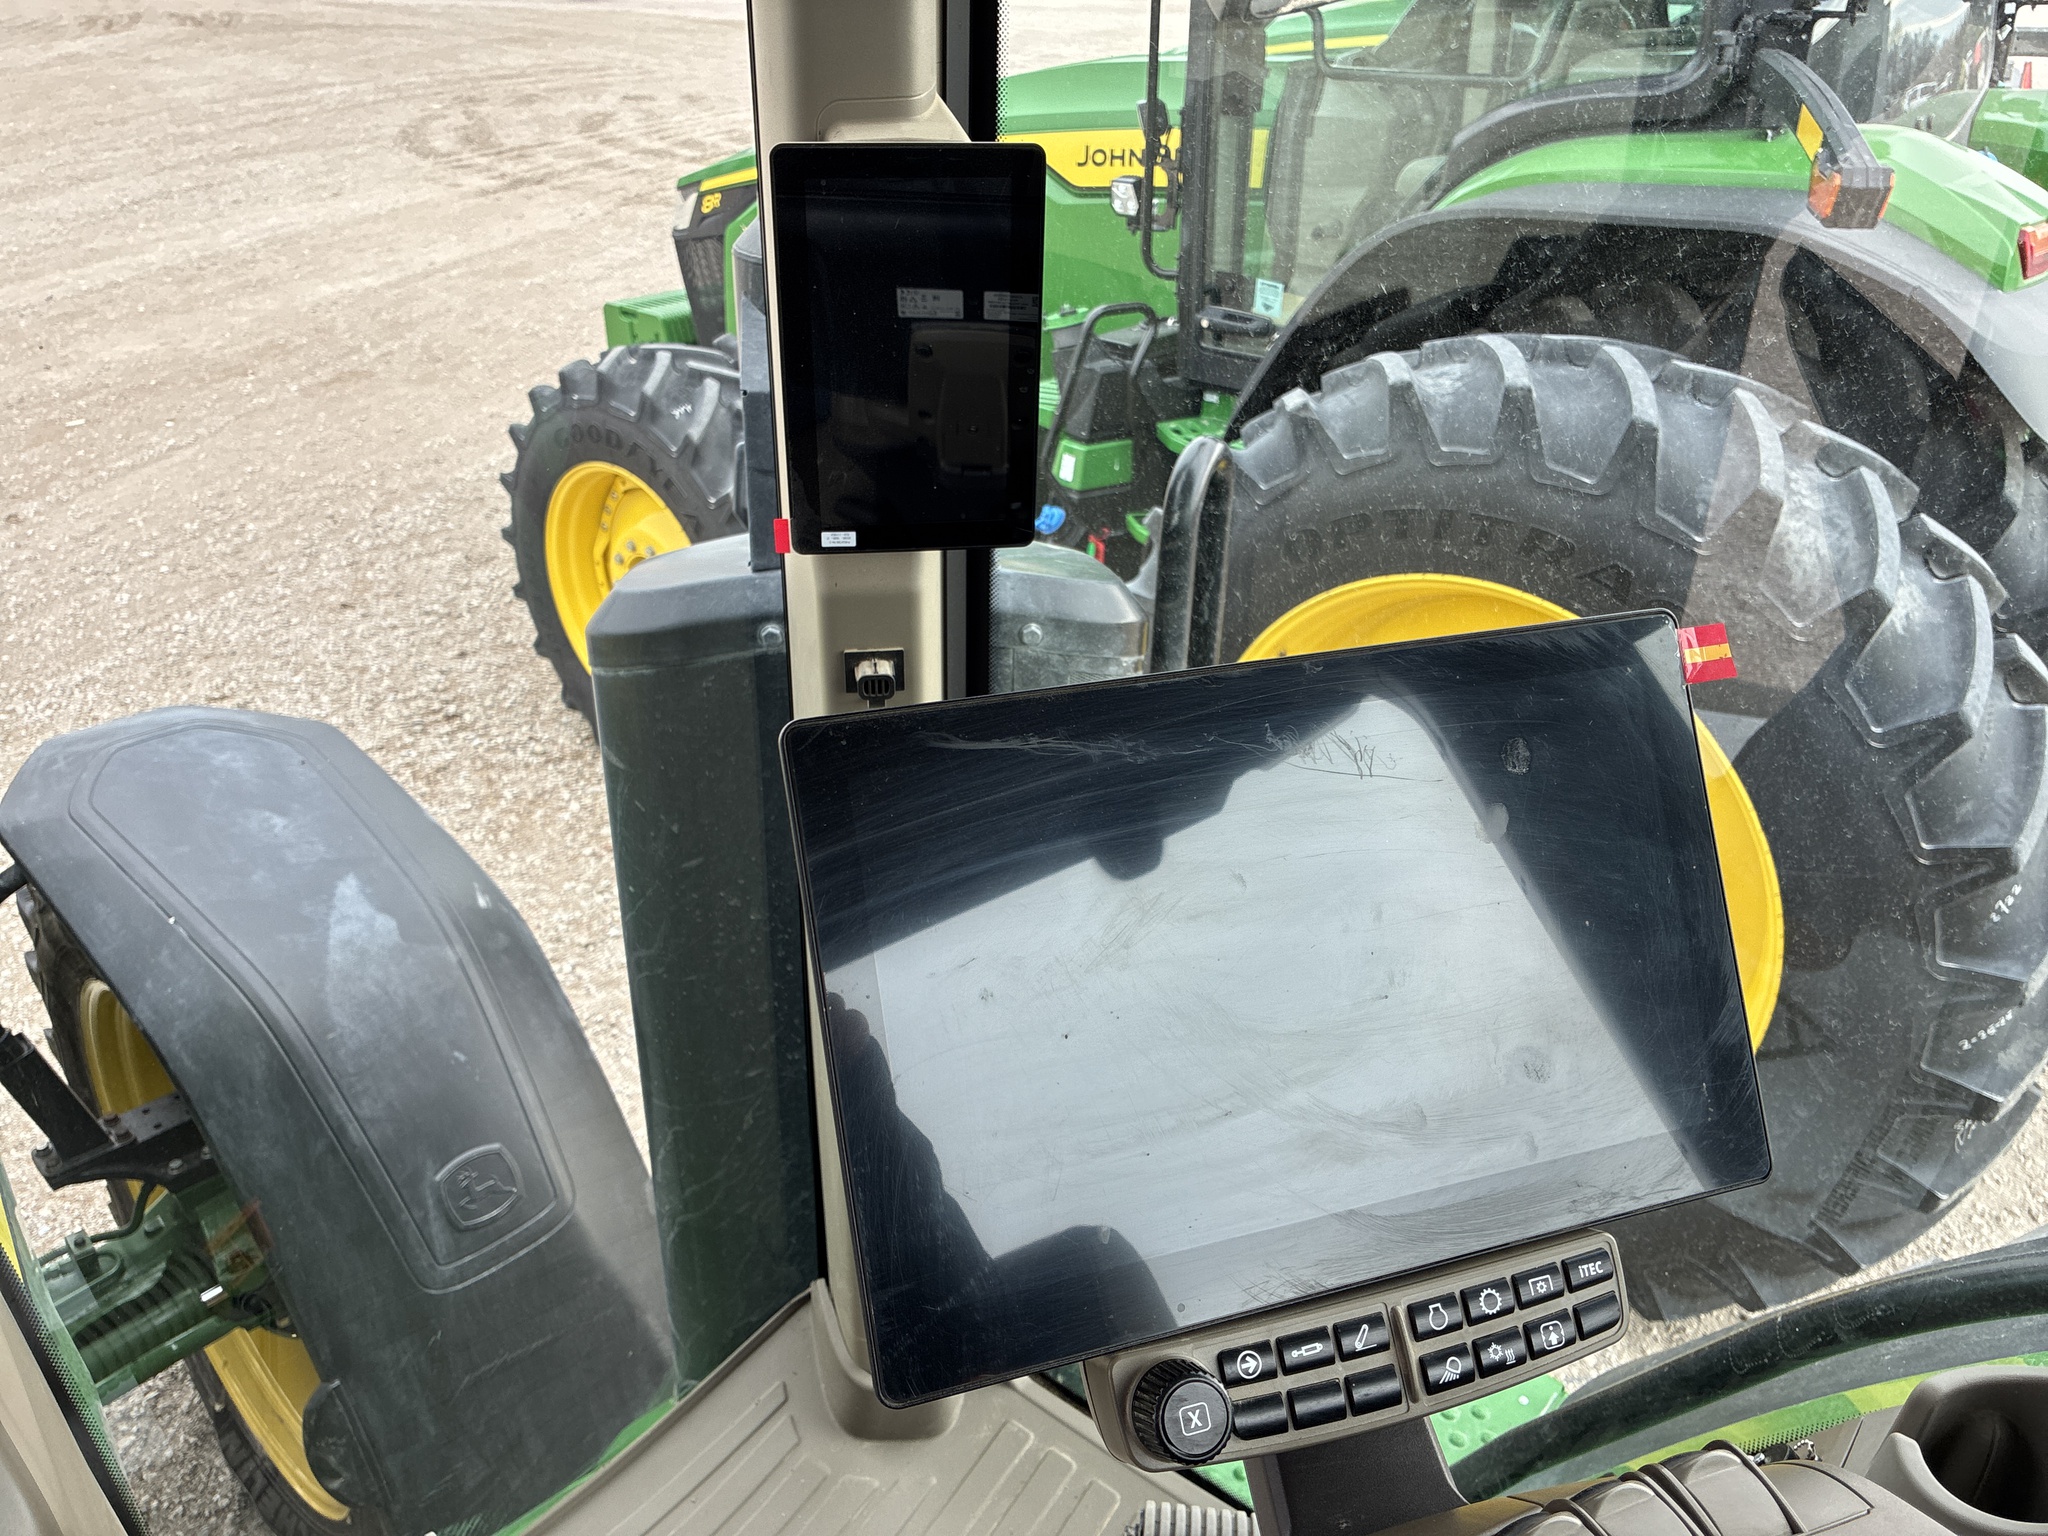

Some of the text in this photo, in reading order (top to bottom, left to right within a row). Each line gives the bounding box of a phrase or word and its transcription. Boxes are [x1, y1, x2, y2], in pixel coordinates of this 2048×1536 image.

[1077, 145, 1146, 168] JOHN
[1578, 1260, 1604, 1278] iTEC
[1187, 1409, 1203, 1429] X
